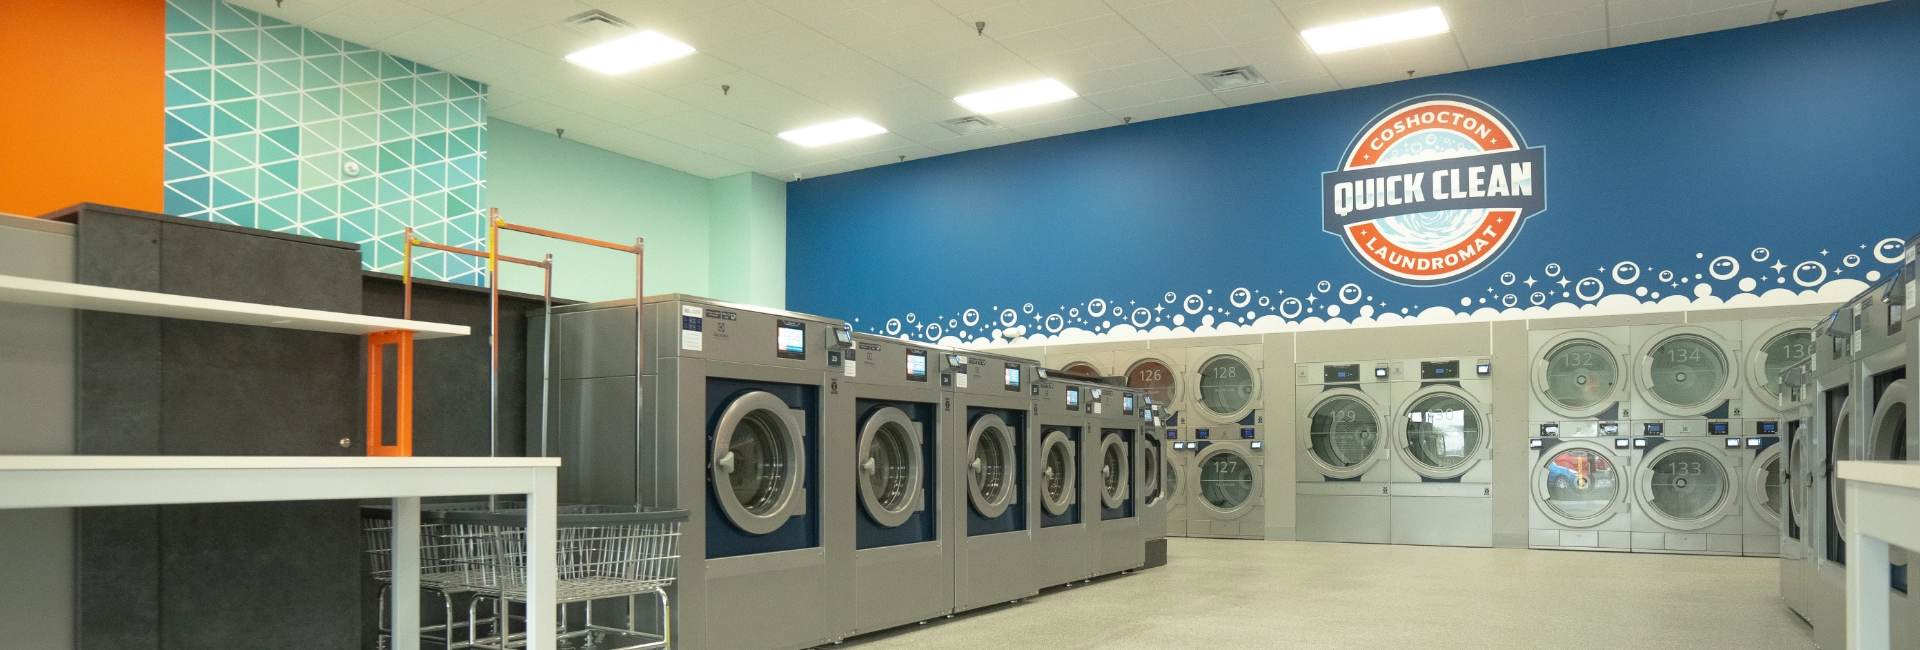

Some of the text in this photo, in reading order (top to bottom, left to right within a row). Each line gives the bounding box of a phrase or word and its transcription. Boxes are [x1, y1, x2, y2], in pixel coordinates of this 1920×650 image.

[1370, 111, 1492, 151] COSHOCTON
[1334, 161, 1533, 217] QUICK CLEAN
[1365, 224, 1498, 271] LAUNDROMAT
[1563, 352, 1593, 366] 132
[1668, 348, 1701, 362] 134
[1140, 369, 1162, 381] 126
[1213, 366, 1236, 379] 128
[1330, 410, 1356, 422] 129
[1427, 408, 1454, 421] 130
[1213, 461, 1237, 473] 127
[1669, 461, 1701, 476] 133
